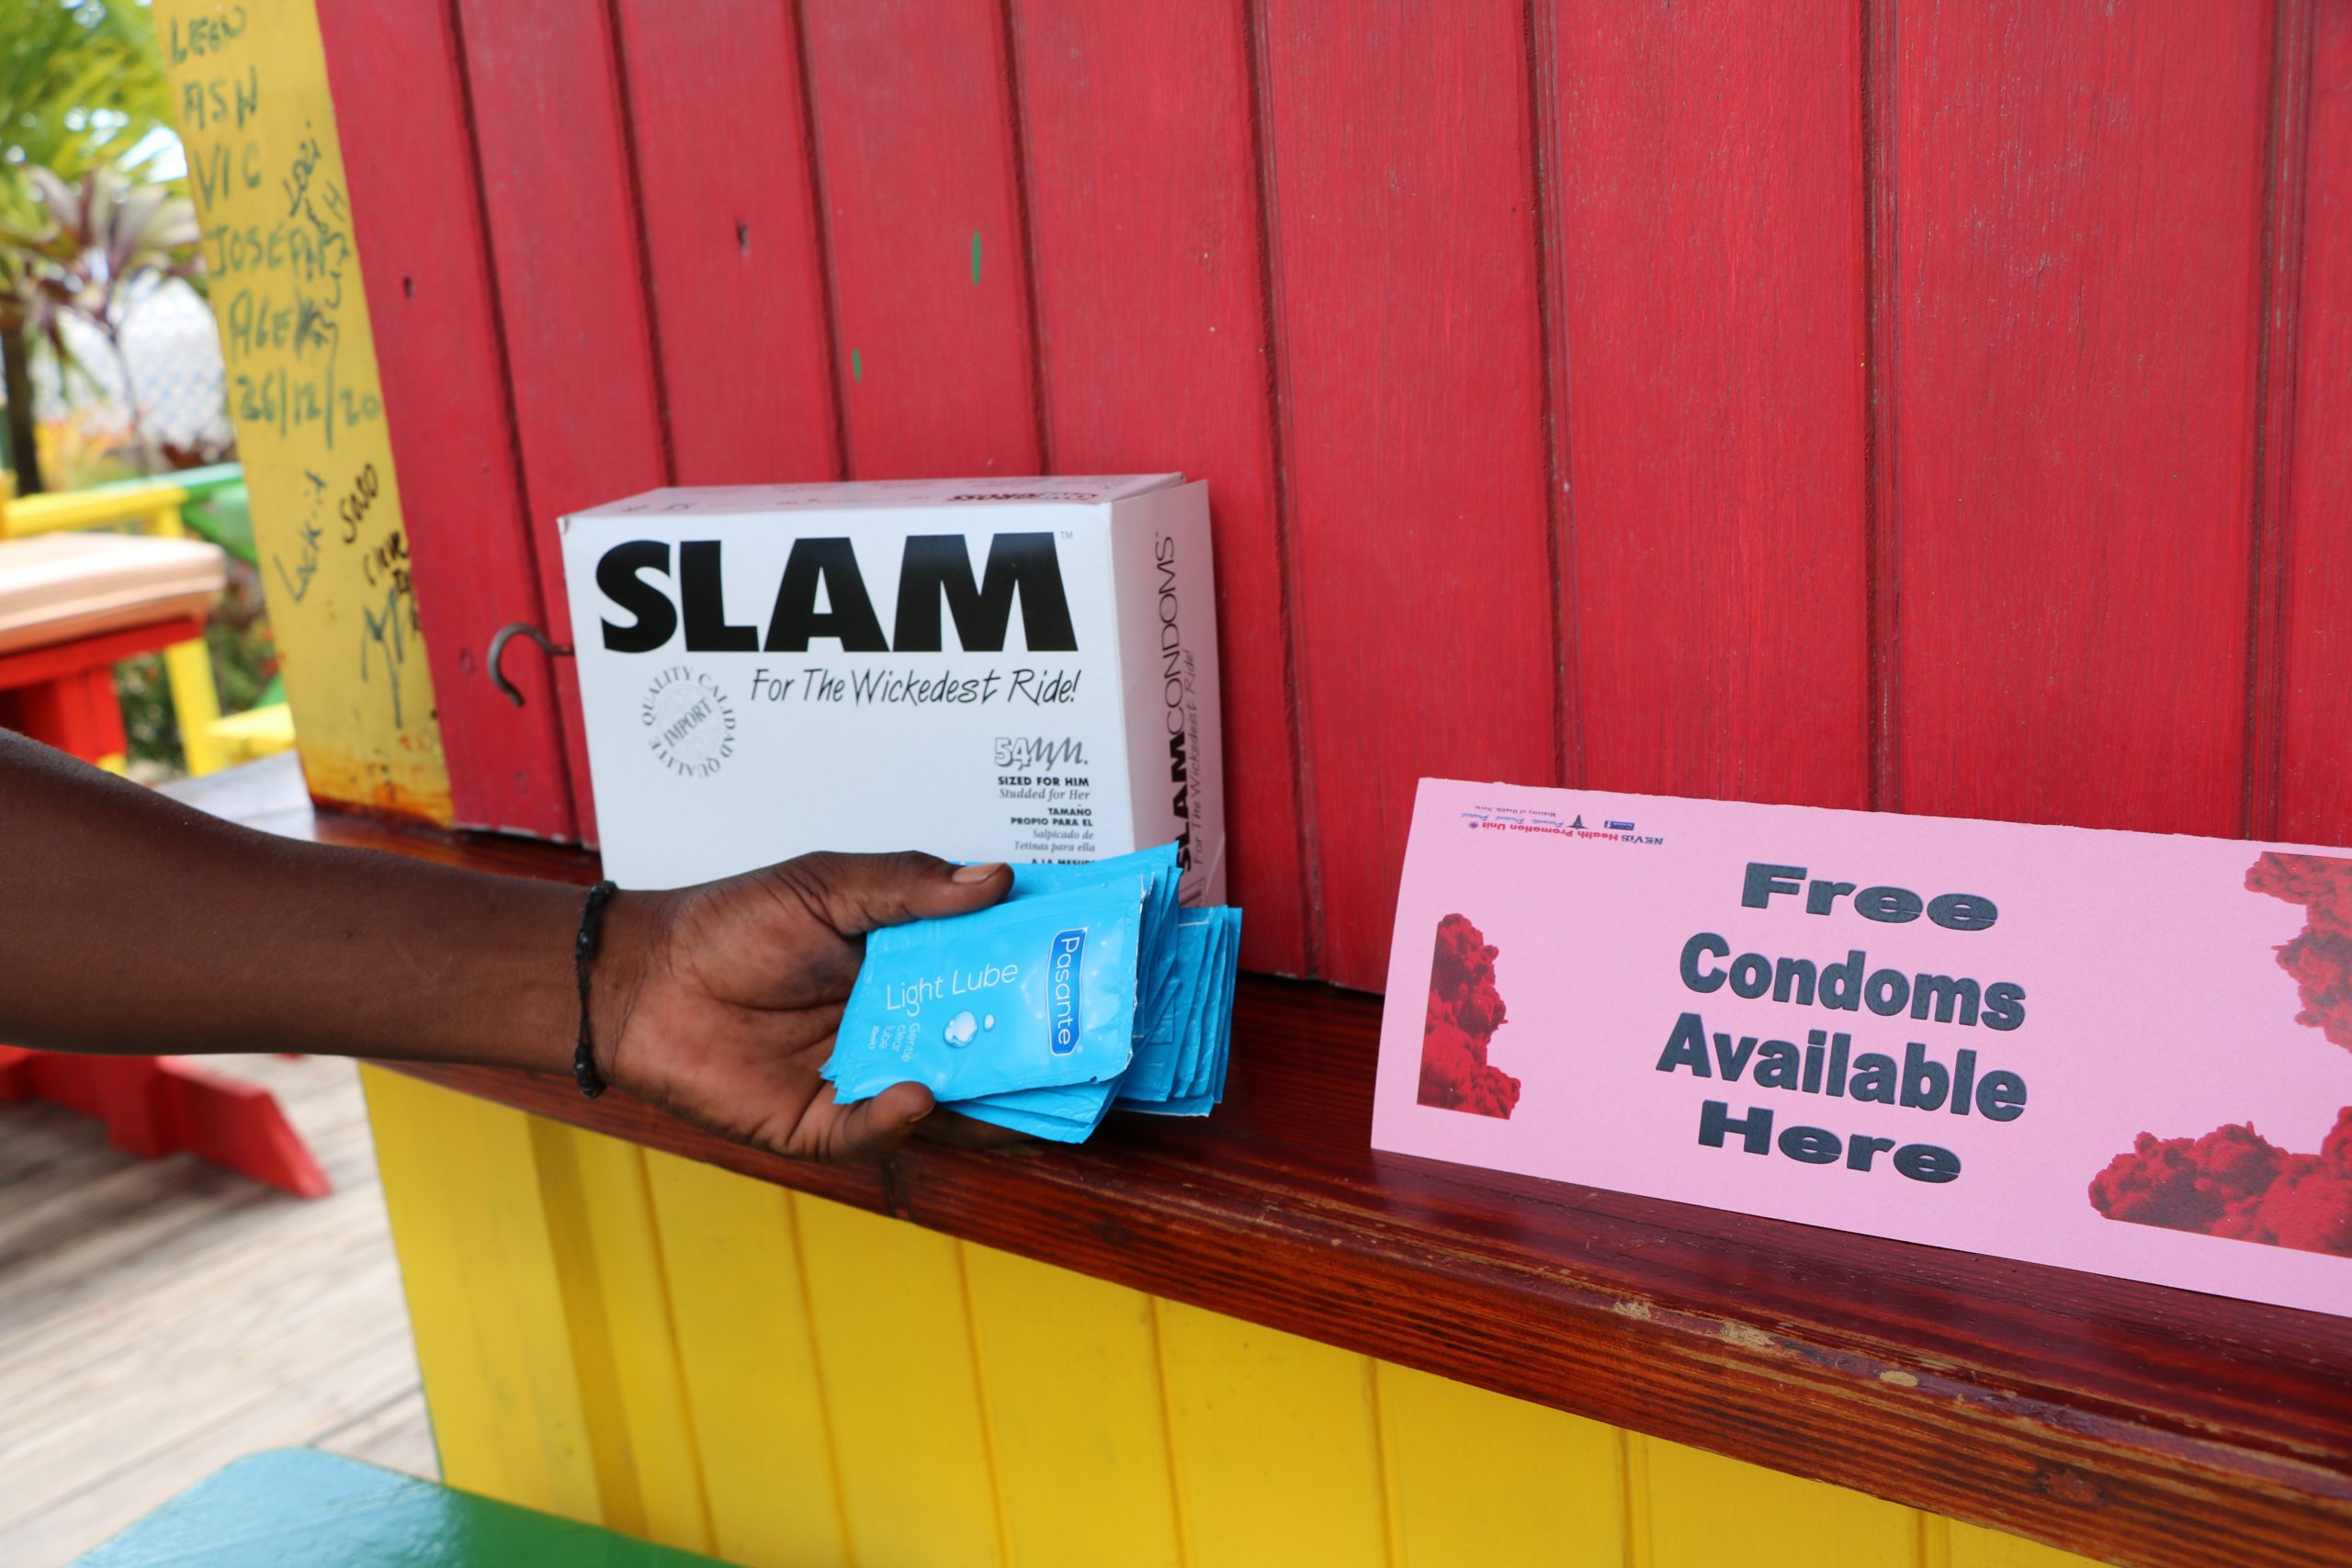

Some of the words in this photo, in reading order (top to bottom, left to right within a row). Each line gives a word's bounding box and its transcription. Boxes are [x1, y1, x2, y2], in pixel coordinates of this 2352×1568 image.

[594, 531, 1080, 653] SLAM
[751, 669, 795, 702] For
[803, 668, 844, 702] The
[851, 669, 1001, 706] Wickedest
[1007, 669, 1082, 705] Ride!
[642, 665, 694, 727] QUALITY
[698, 673, 736, 758] CALIDAD
[663, 698, 712, 748] IMPORT
[1186, 701, 1203, 799] Wickedest
[998, 776, 1032, 786] SIZED
[1036, 776, 1060, 786] FOR
[1065, 777, 1090, 787] HIM
[999, 787, 1046, 799] Studded
[1046, 788, 1066, 803] for
[1069, 789, 1091, 800] Her
[1011, 817, 1048, 826] PROPIO
[1052, 818, 1079, 826] PARA
[1082, 818, 1093, 827] EL
[1032, 829, 1080, 840] Salpicado
[1082, 829, 1094, 840] de
[1191, 799, 1204, 829] The
[1482, 821, 1507, 830] Unit
[1510, 824, 1573, 838] Promotion
[1050, 843, 1075, 852] para
[1077, 841, 1095, 852] ella
[1577, 830, 1618, 841] Health
[1740, 861, 1999, 931] Free
[886, 976, 944, 1017] Light
[951, 964, 1018, 995] Lube
[1054, 935, 1080, 1045] Pasante
[1679, 932, 2027, 1032] Condoms
[901, 1022, 921, 1063] Gentle
[1656, 1011, 2027, 1122] Available
[1698, 1100, 1962, 1184] Here
